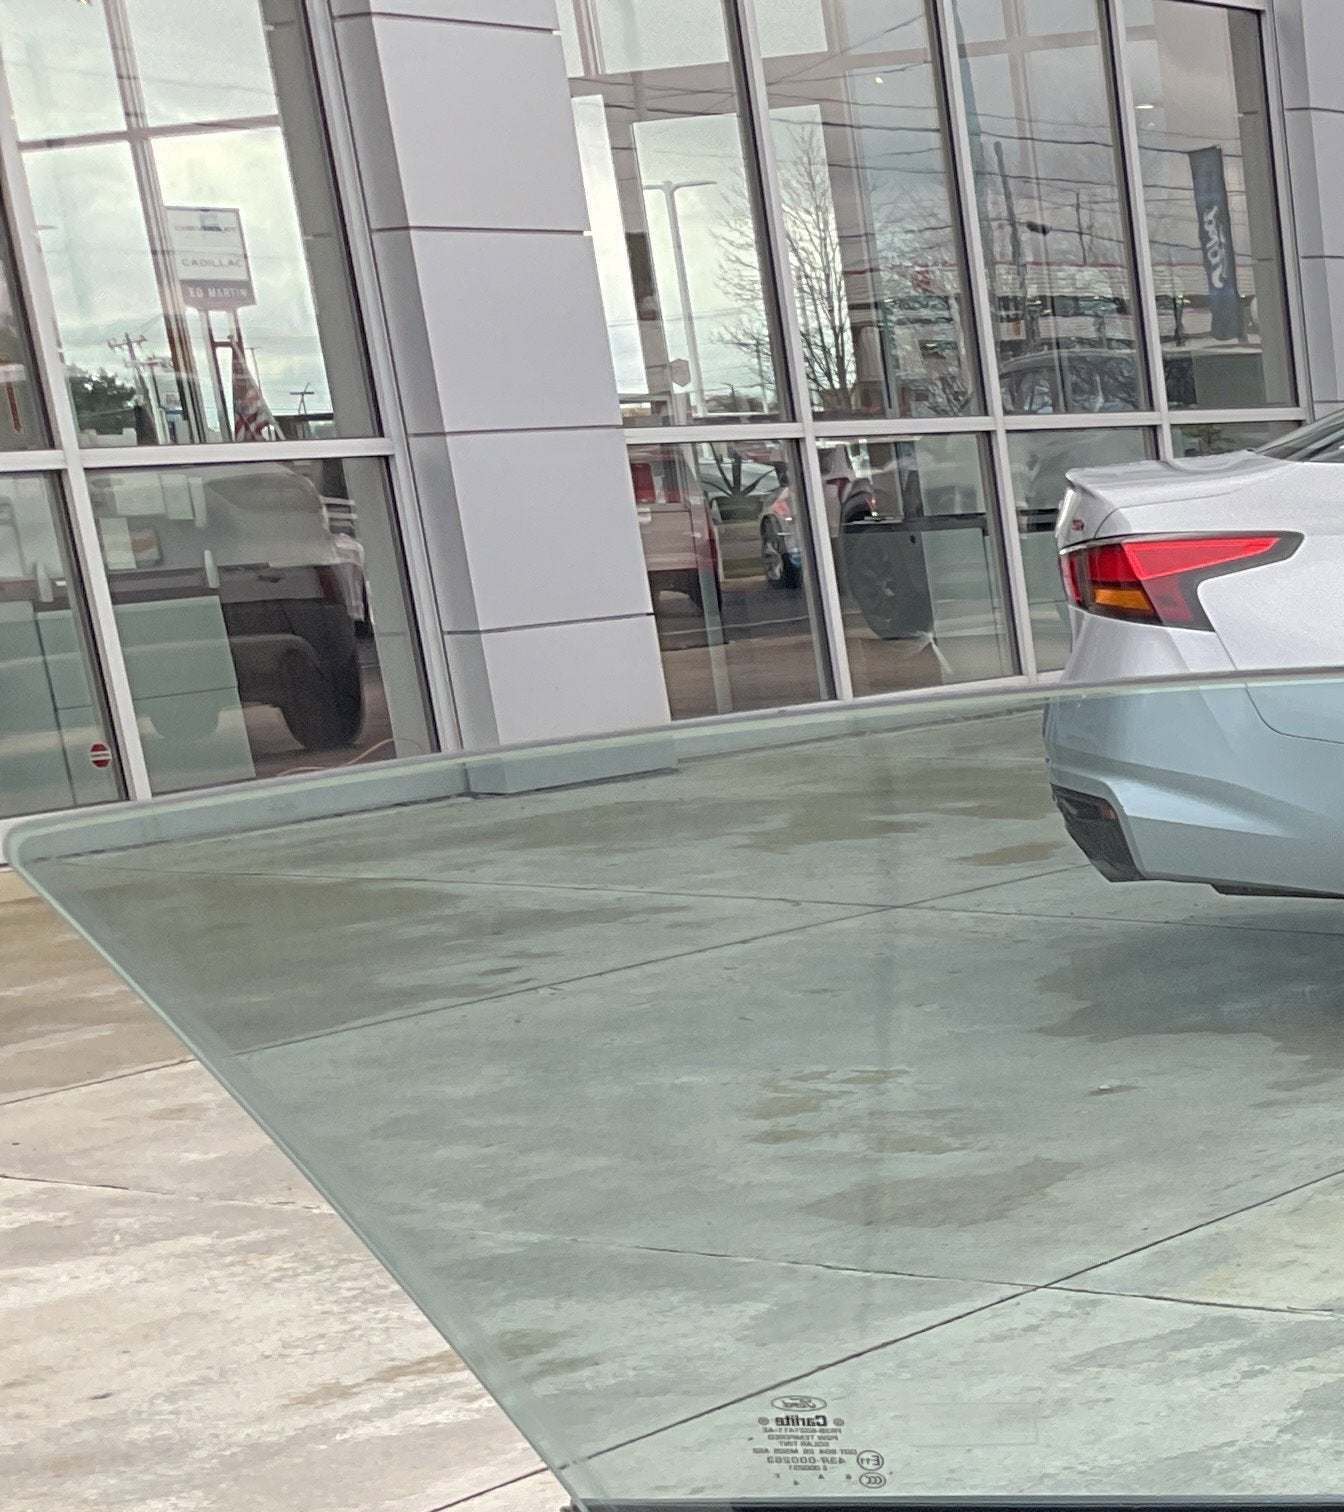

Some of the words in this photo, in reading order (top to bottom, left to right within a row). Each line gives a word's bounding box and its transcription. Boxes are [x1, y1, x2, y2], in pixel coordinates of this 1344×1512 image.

[181, 259, 244, 268] CADILLAC
[188, 287, 204, 299] ED
[207, 287, 249, 299] MARTIN
